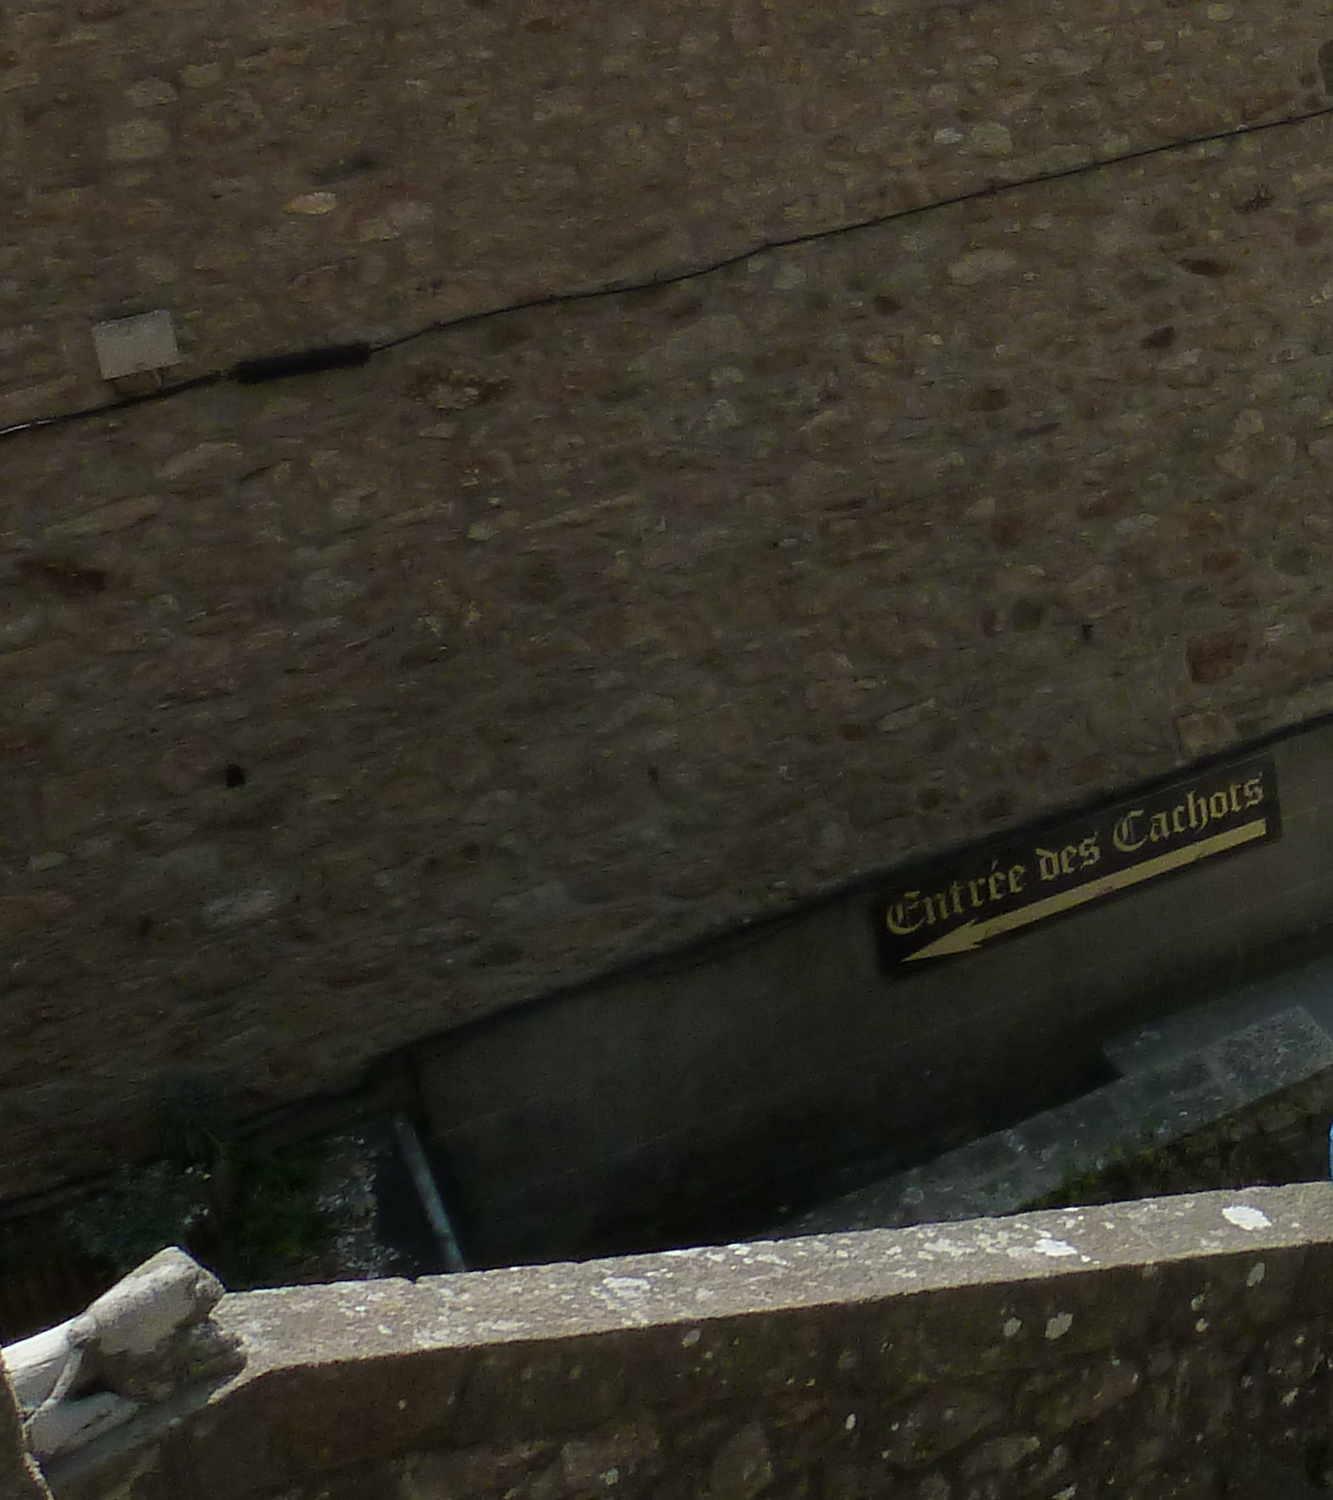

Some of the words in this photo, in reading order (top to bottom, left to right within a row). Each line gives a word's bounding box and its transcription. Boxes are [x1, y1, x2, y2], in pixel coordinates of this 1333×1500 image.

[886, 860, 1025, 934] Entrée
[1035, 830, 1101, 881] des
[1113, 773, 1264, 852] Cachots
